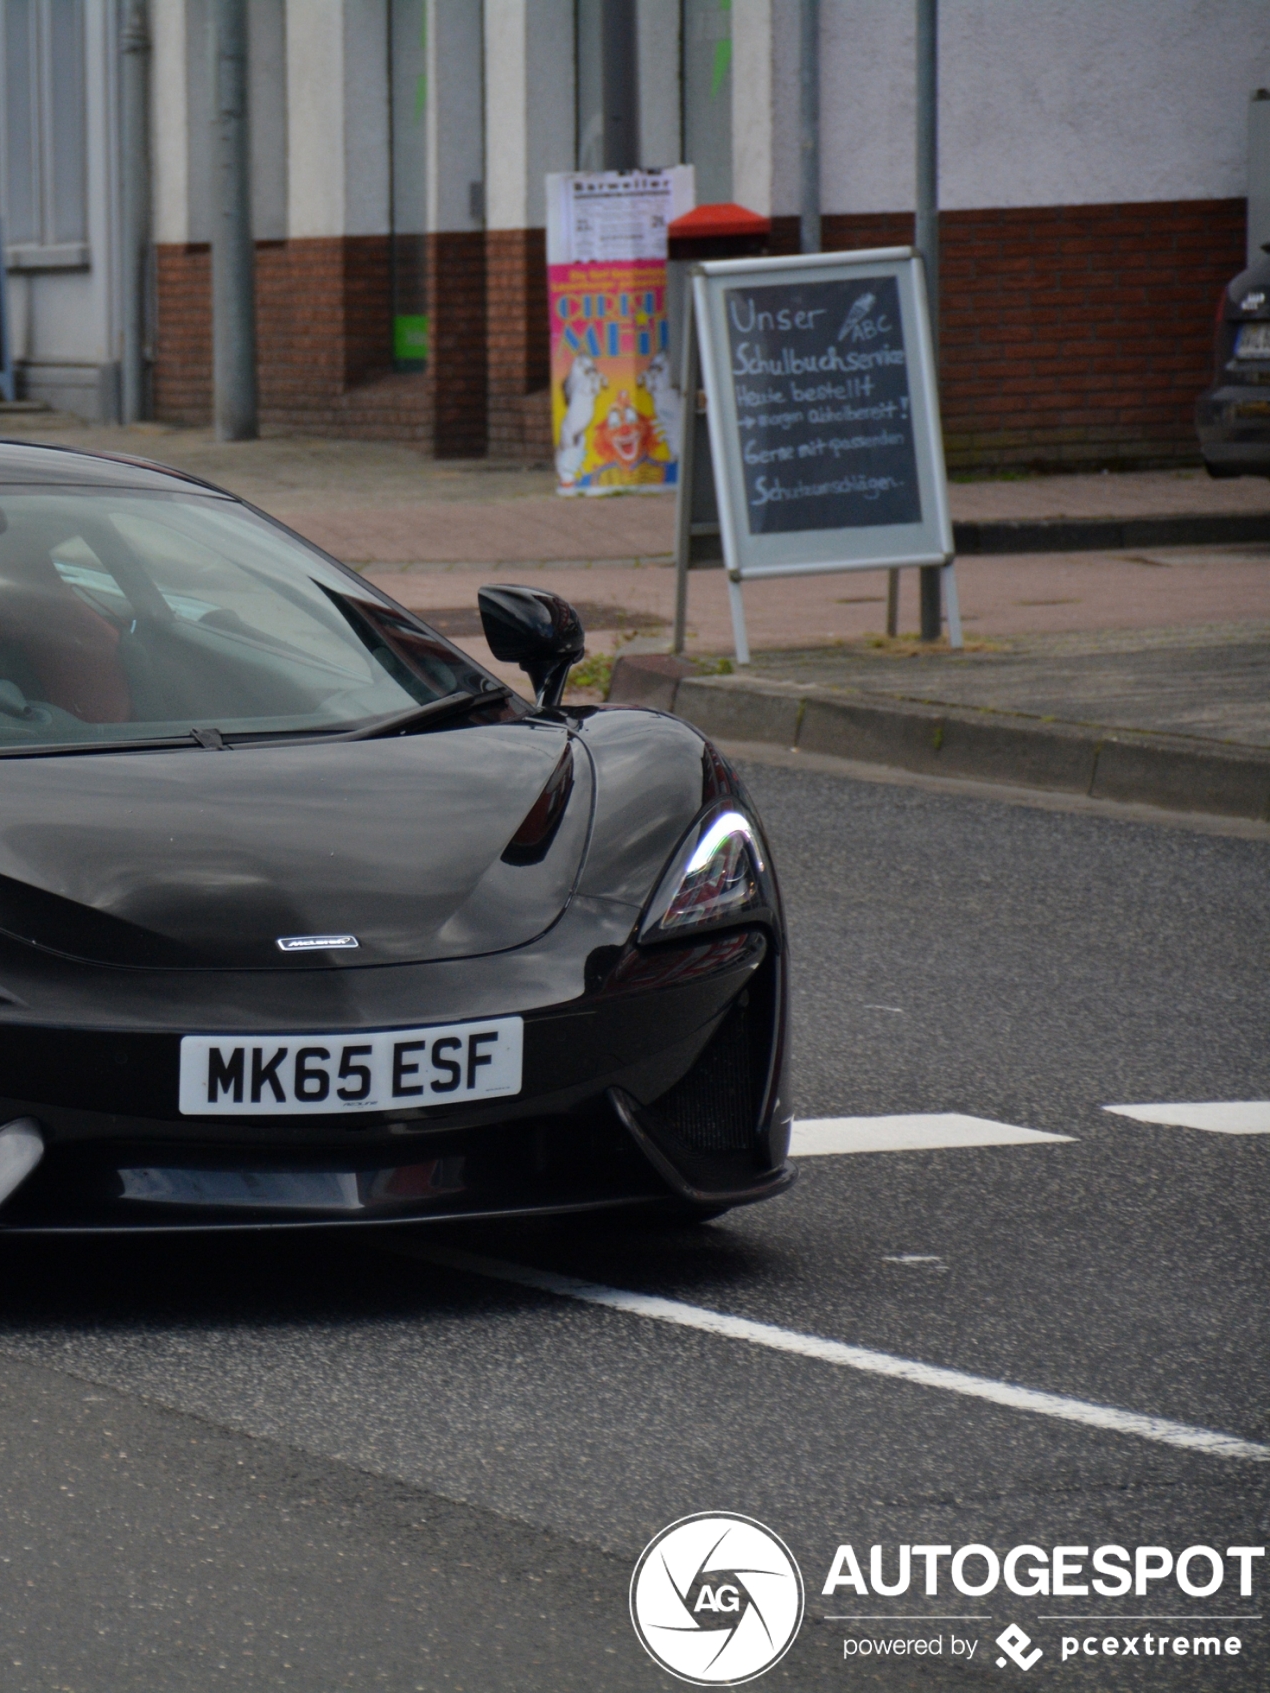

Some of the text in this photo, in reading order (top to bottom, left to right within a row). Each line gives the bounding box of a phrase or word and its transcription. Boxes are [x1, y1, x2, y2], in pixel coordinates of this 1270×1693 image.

[730, 298, 827, 333] Unser
[851, 314, 892, 342] ABC
[731, 342, 906, 376] Schulbuchservice
[790, 375, 875, 401] bestellt
[744, 439, 794, 465] Gerne
[797, 438, 828, 458] mit
[207, 1031, 498, 1103] MK65 ESF
